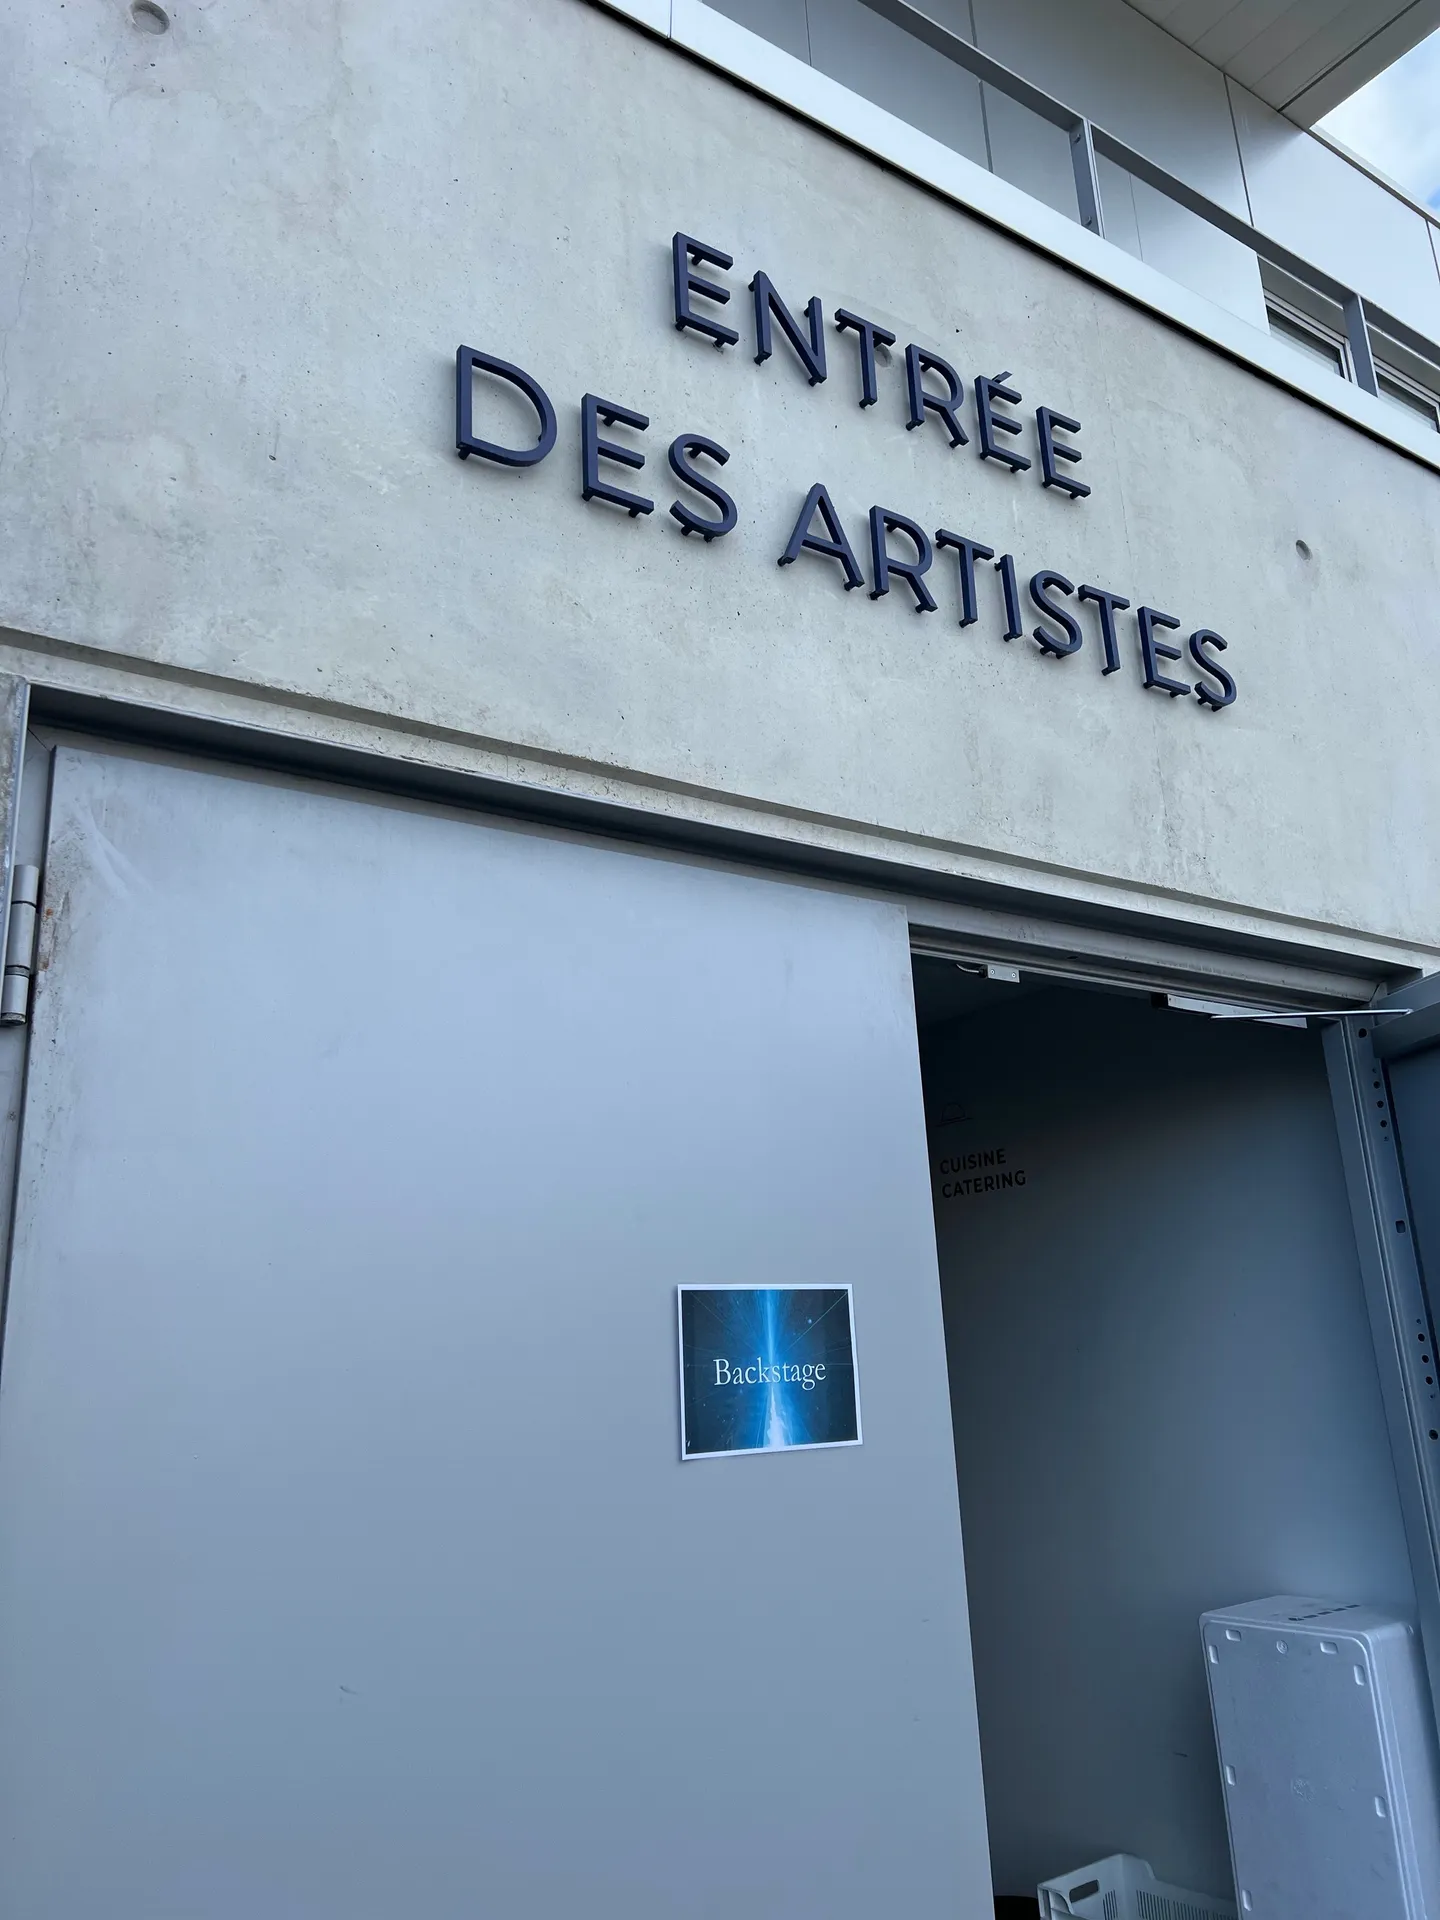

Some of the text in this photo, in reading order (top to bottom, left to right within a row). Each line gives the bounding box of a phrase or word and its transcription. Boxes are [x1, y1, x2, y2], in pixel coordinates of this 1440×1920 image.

[672, 232, 1091, 498] ENTRÉE
[456, 345, 1237, 711] DES ARTISTES
[939, 1148, 1006, 1175] CUISINE
[941, 1170, 1026, 1198] CATERING
[712, 1357, 827, 1391] Backstage
